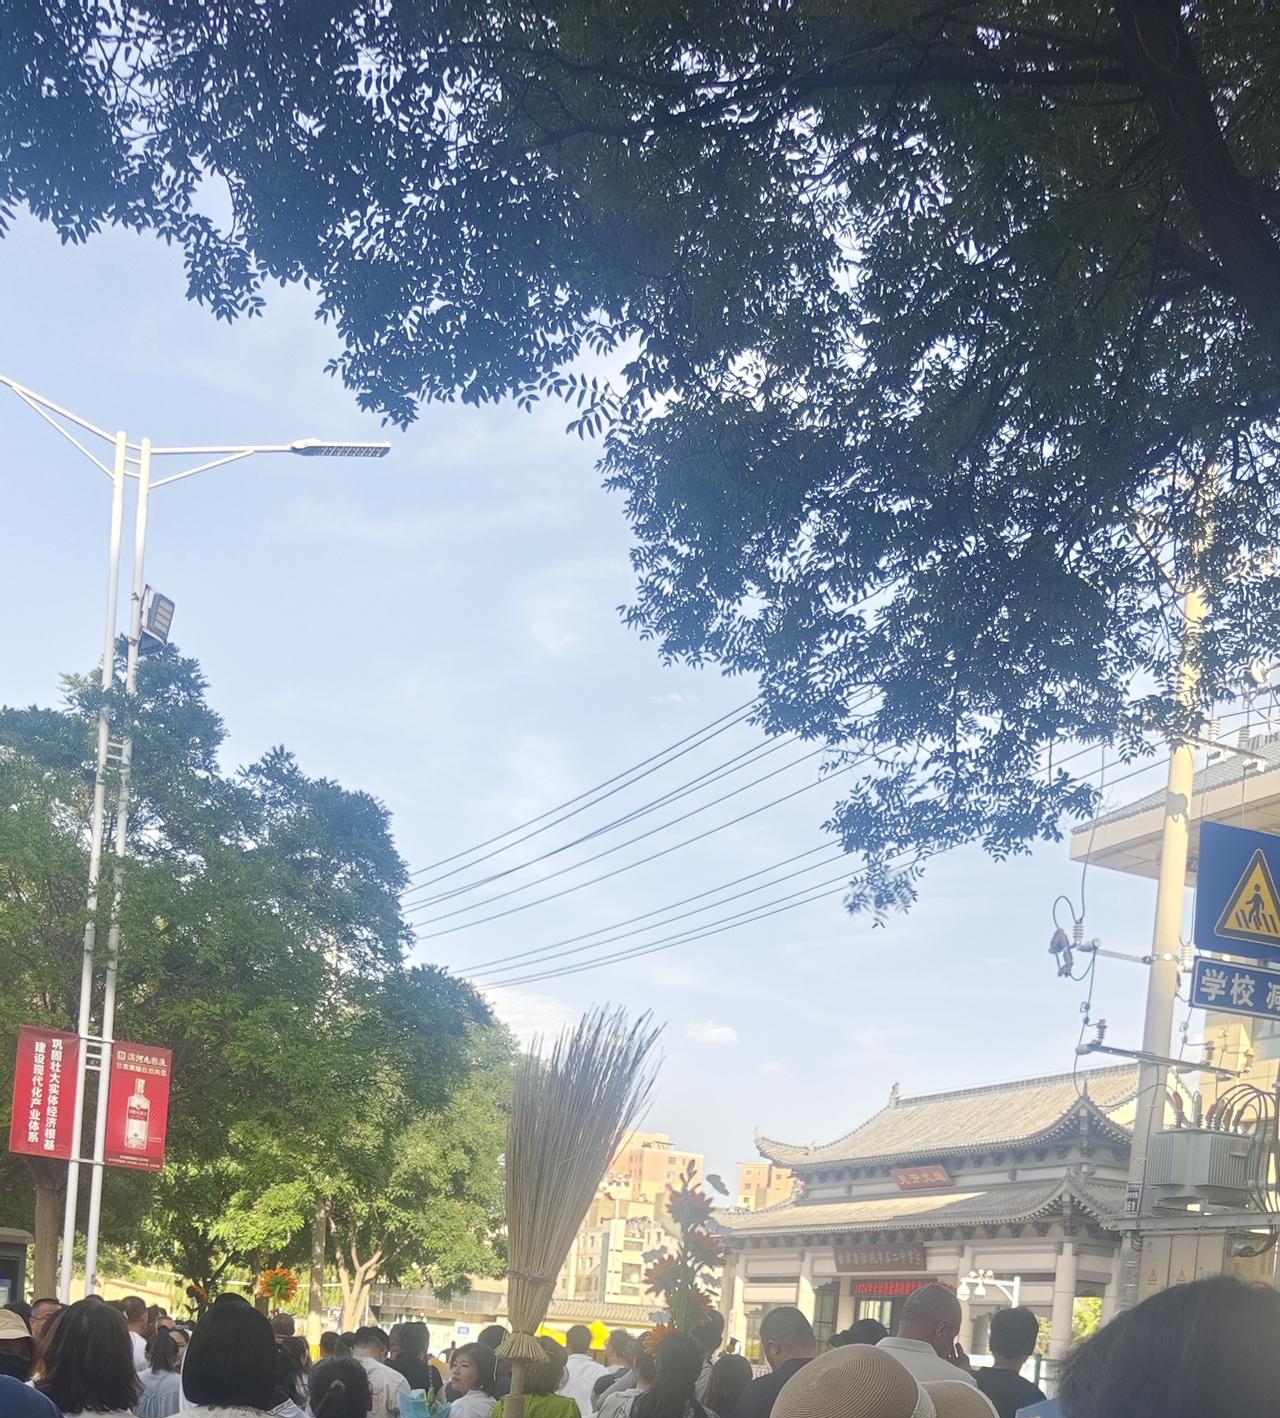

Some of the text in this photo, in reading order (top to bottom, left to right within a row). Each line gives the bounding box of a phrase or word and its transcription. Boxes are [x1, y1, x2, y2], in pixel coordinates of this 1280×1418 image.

[28, 1042, 46, 1143] 建设现代化产业体系
[44, 1039, 63, 1151] 巩固壮大实体经济根基
